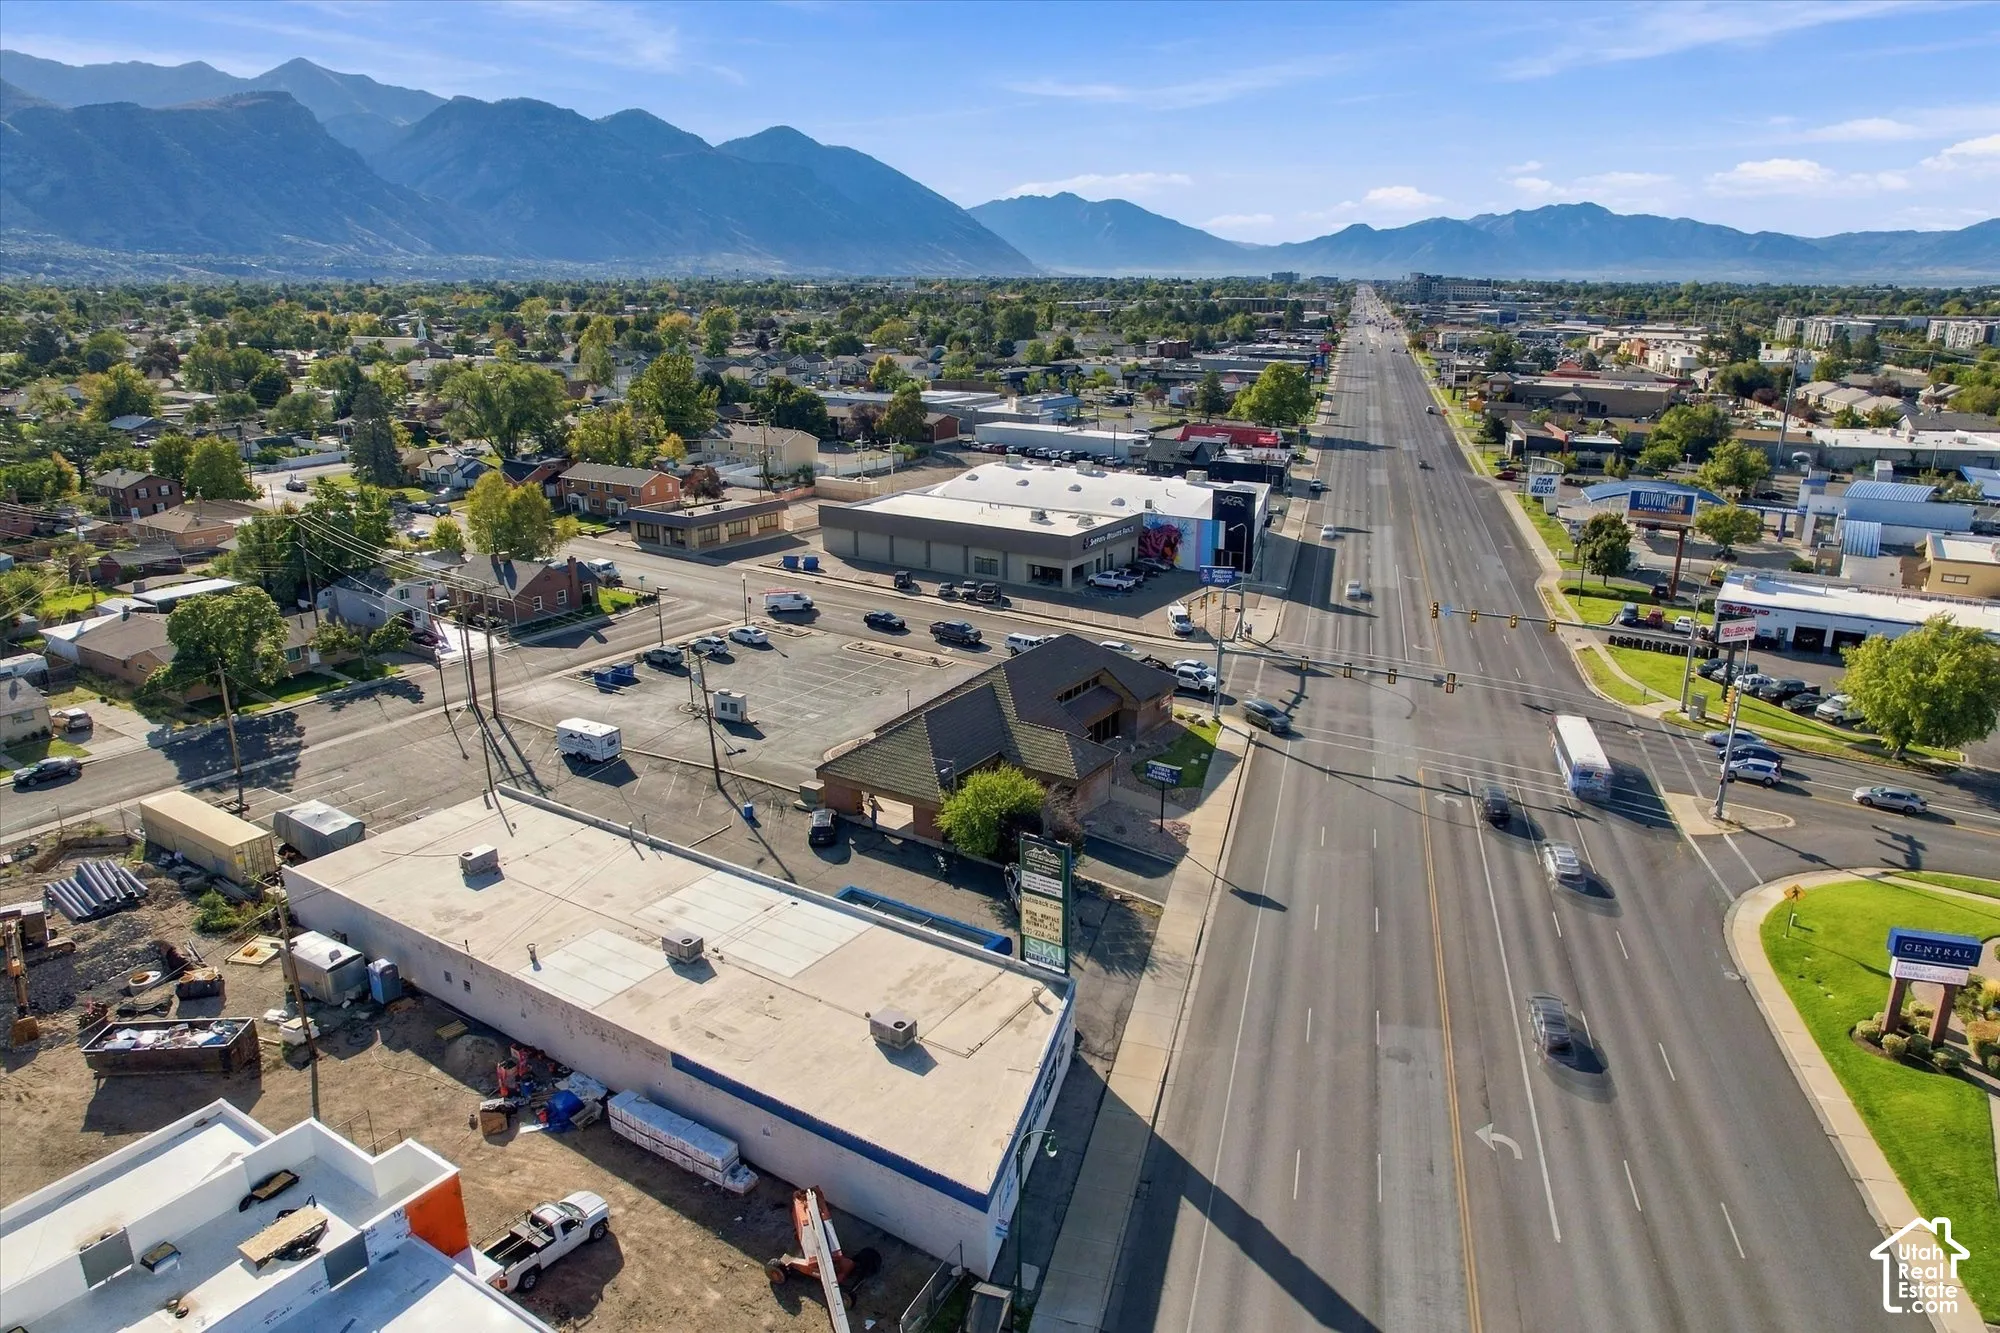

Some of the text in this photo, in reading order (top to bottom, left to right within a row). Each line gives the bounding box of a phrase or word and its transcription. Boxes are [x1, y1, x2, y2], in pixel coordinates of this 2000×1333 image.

[1531, 485, 1556, 494] WASH
[1535, 477, 1553, 486] CAR
[1639, 492, 1684, 508] ADVANCED
[1028, 939, 1062, 960] SKI
[1904, 943, 1970, 959] CENTRAL
